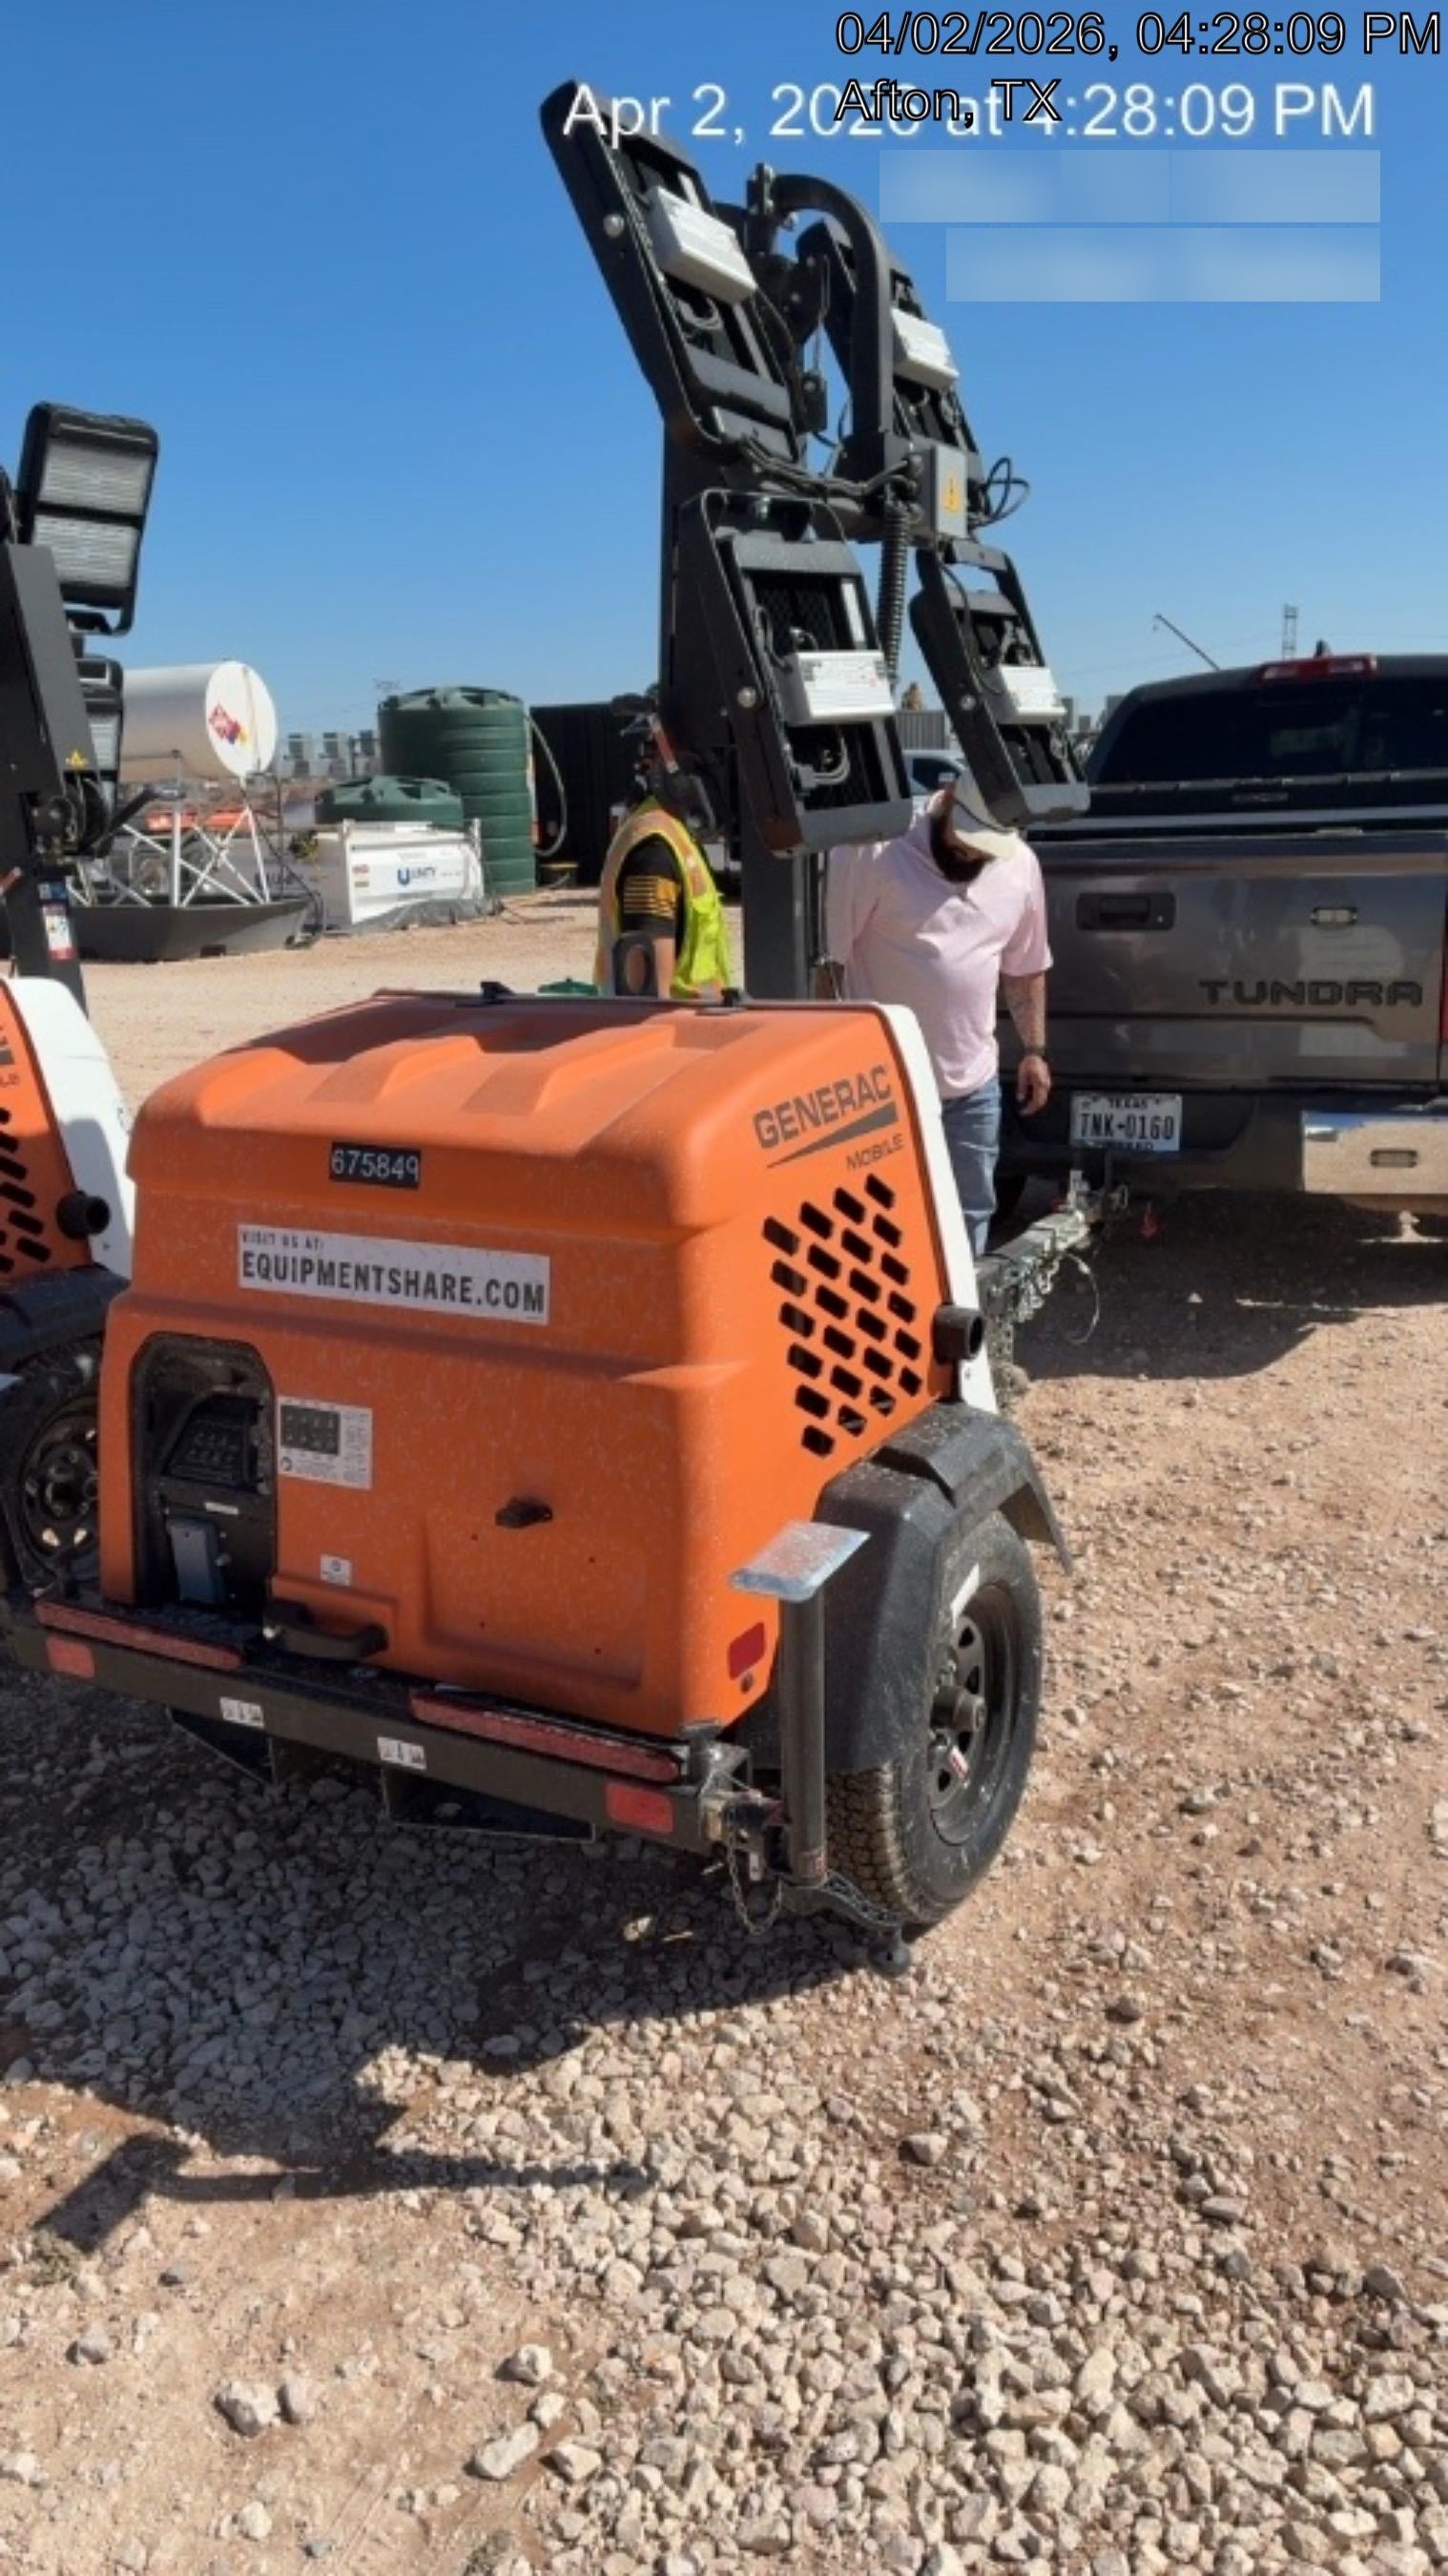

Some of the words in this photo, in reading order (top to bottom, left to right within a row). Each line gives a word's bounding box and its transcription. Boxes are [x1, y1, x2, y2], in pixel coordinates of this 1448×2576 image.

[1198, 980, 1424, 1007] TUNDRA
[753, 1065, 891, 1148] GENERAC
[331, 1149, 420, 1182] 675849
[242, 1251, 546, 1314] EQUIPMENTSHARE.COM
